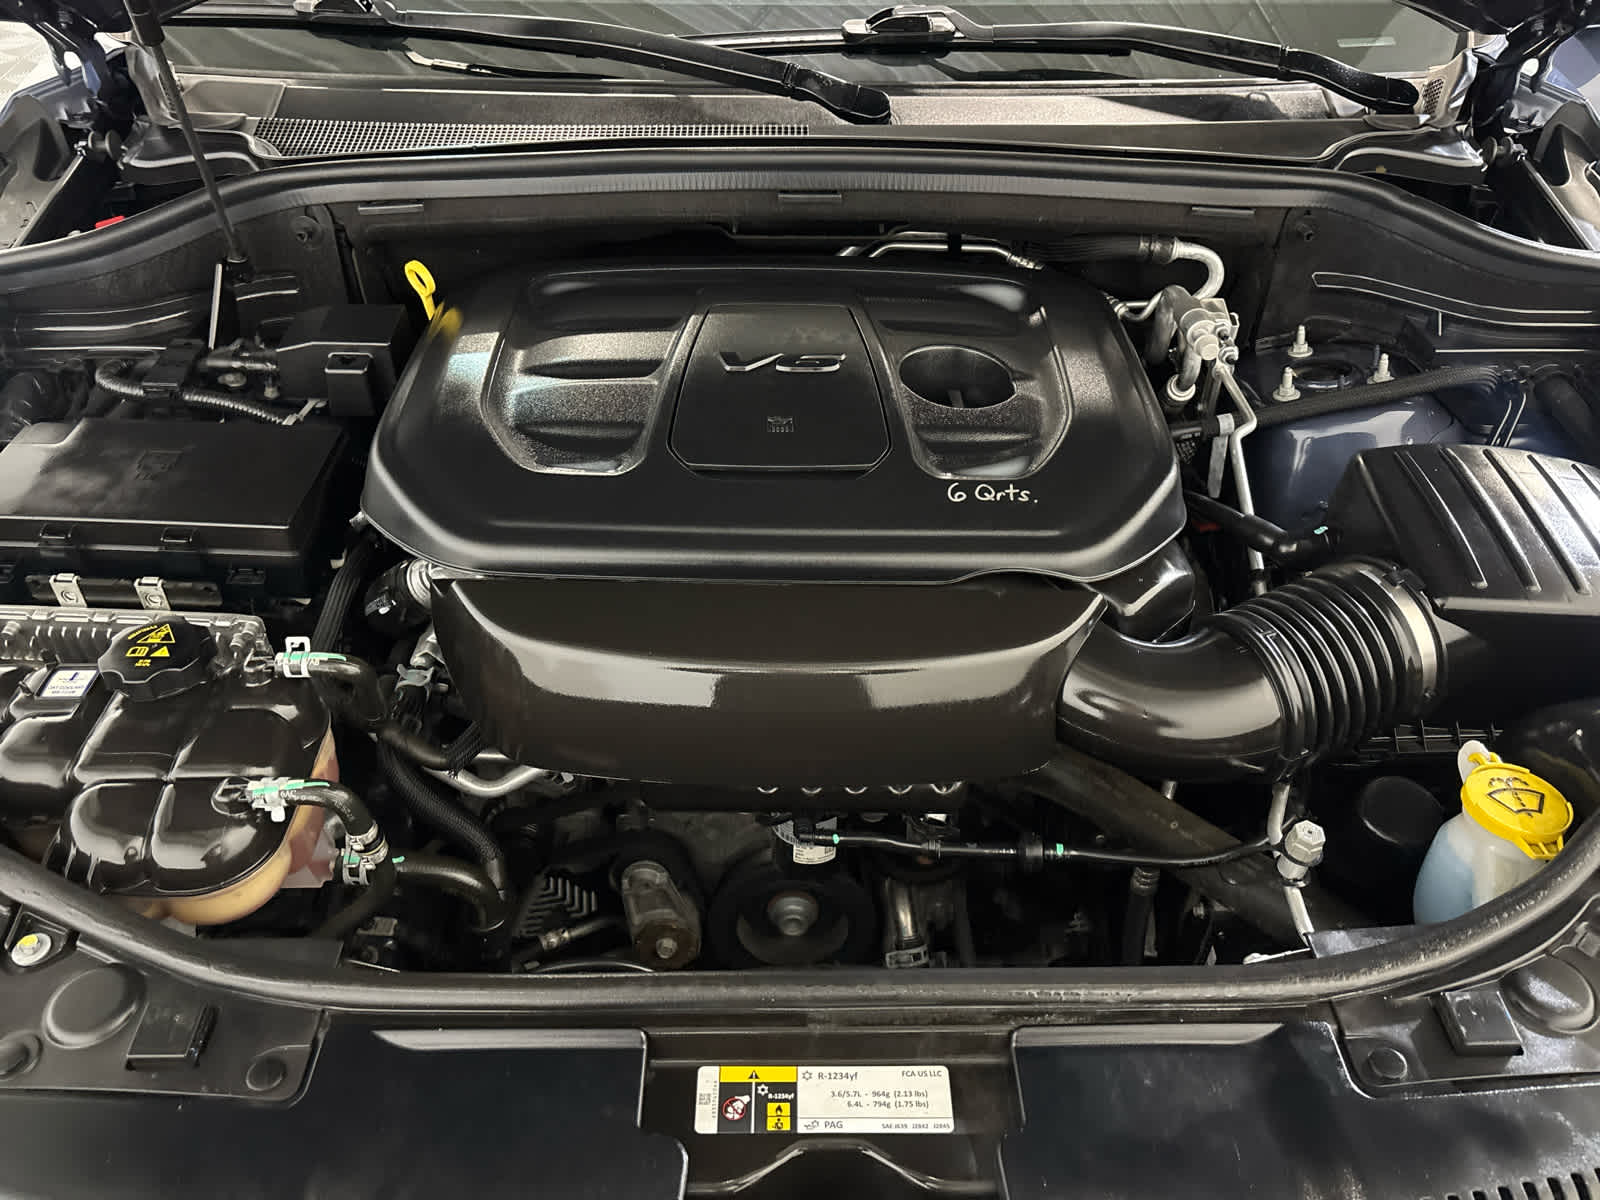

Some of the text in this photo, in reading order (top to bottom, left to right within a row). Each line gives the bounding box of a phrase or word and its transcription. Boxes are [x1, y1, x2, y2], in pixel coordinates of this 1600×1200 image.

[719, 351, 847, 373] V6
[947, 482, 1038, 503] 6 Qrts.
[818, 1071, 858, 1081] R-1234yf
[831, 1090, 862, 1099] 3.6/5.7L
[871, 1090, 890, 1099] 964g
[894, 1090, 912, 1099] (2.13
[914, 1090, 928, 1098] lbs)
[873, 1101, 891, 1109] 794g
[894, 1100, 913, 1108] (1.75
[915, 1100, 929, 1108] lbs)
[824, 1120, 844, 1129] PAG
